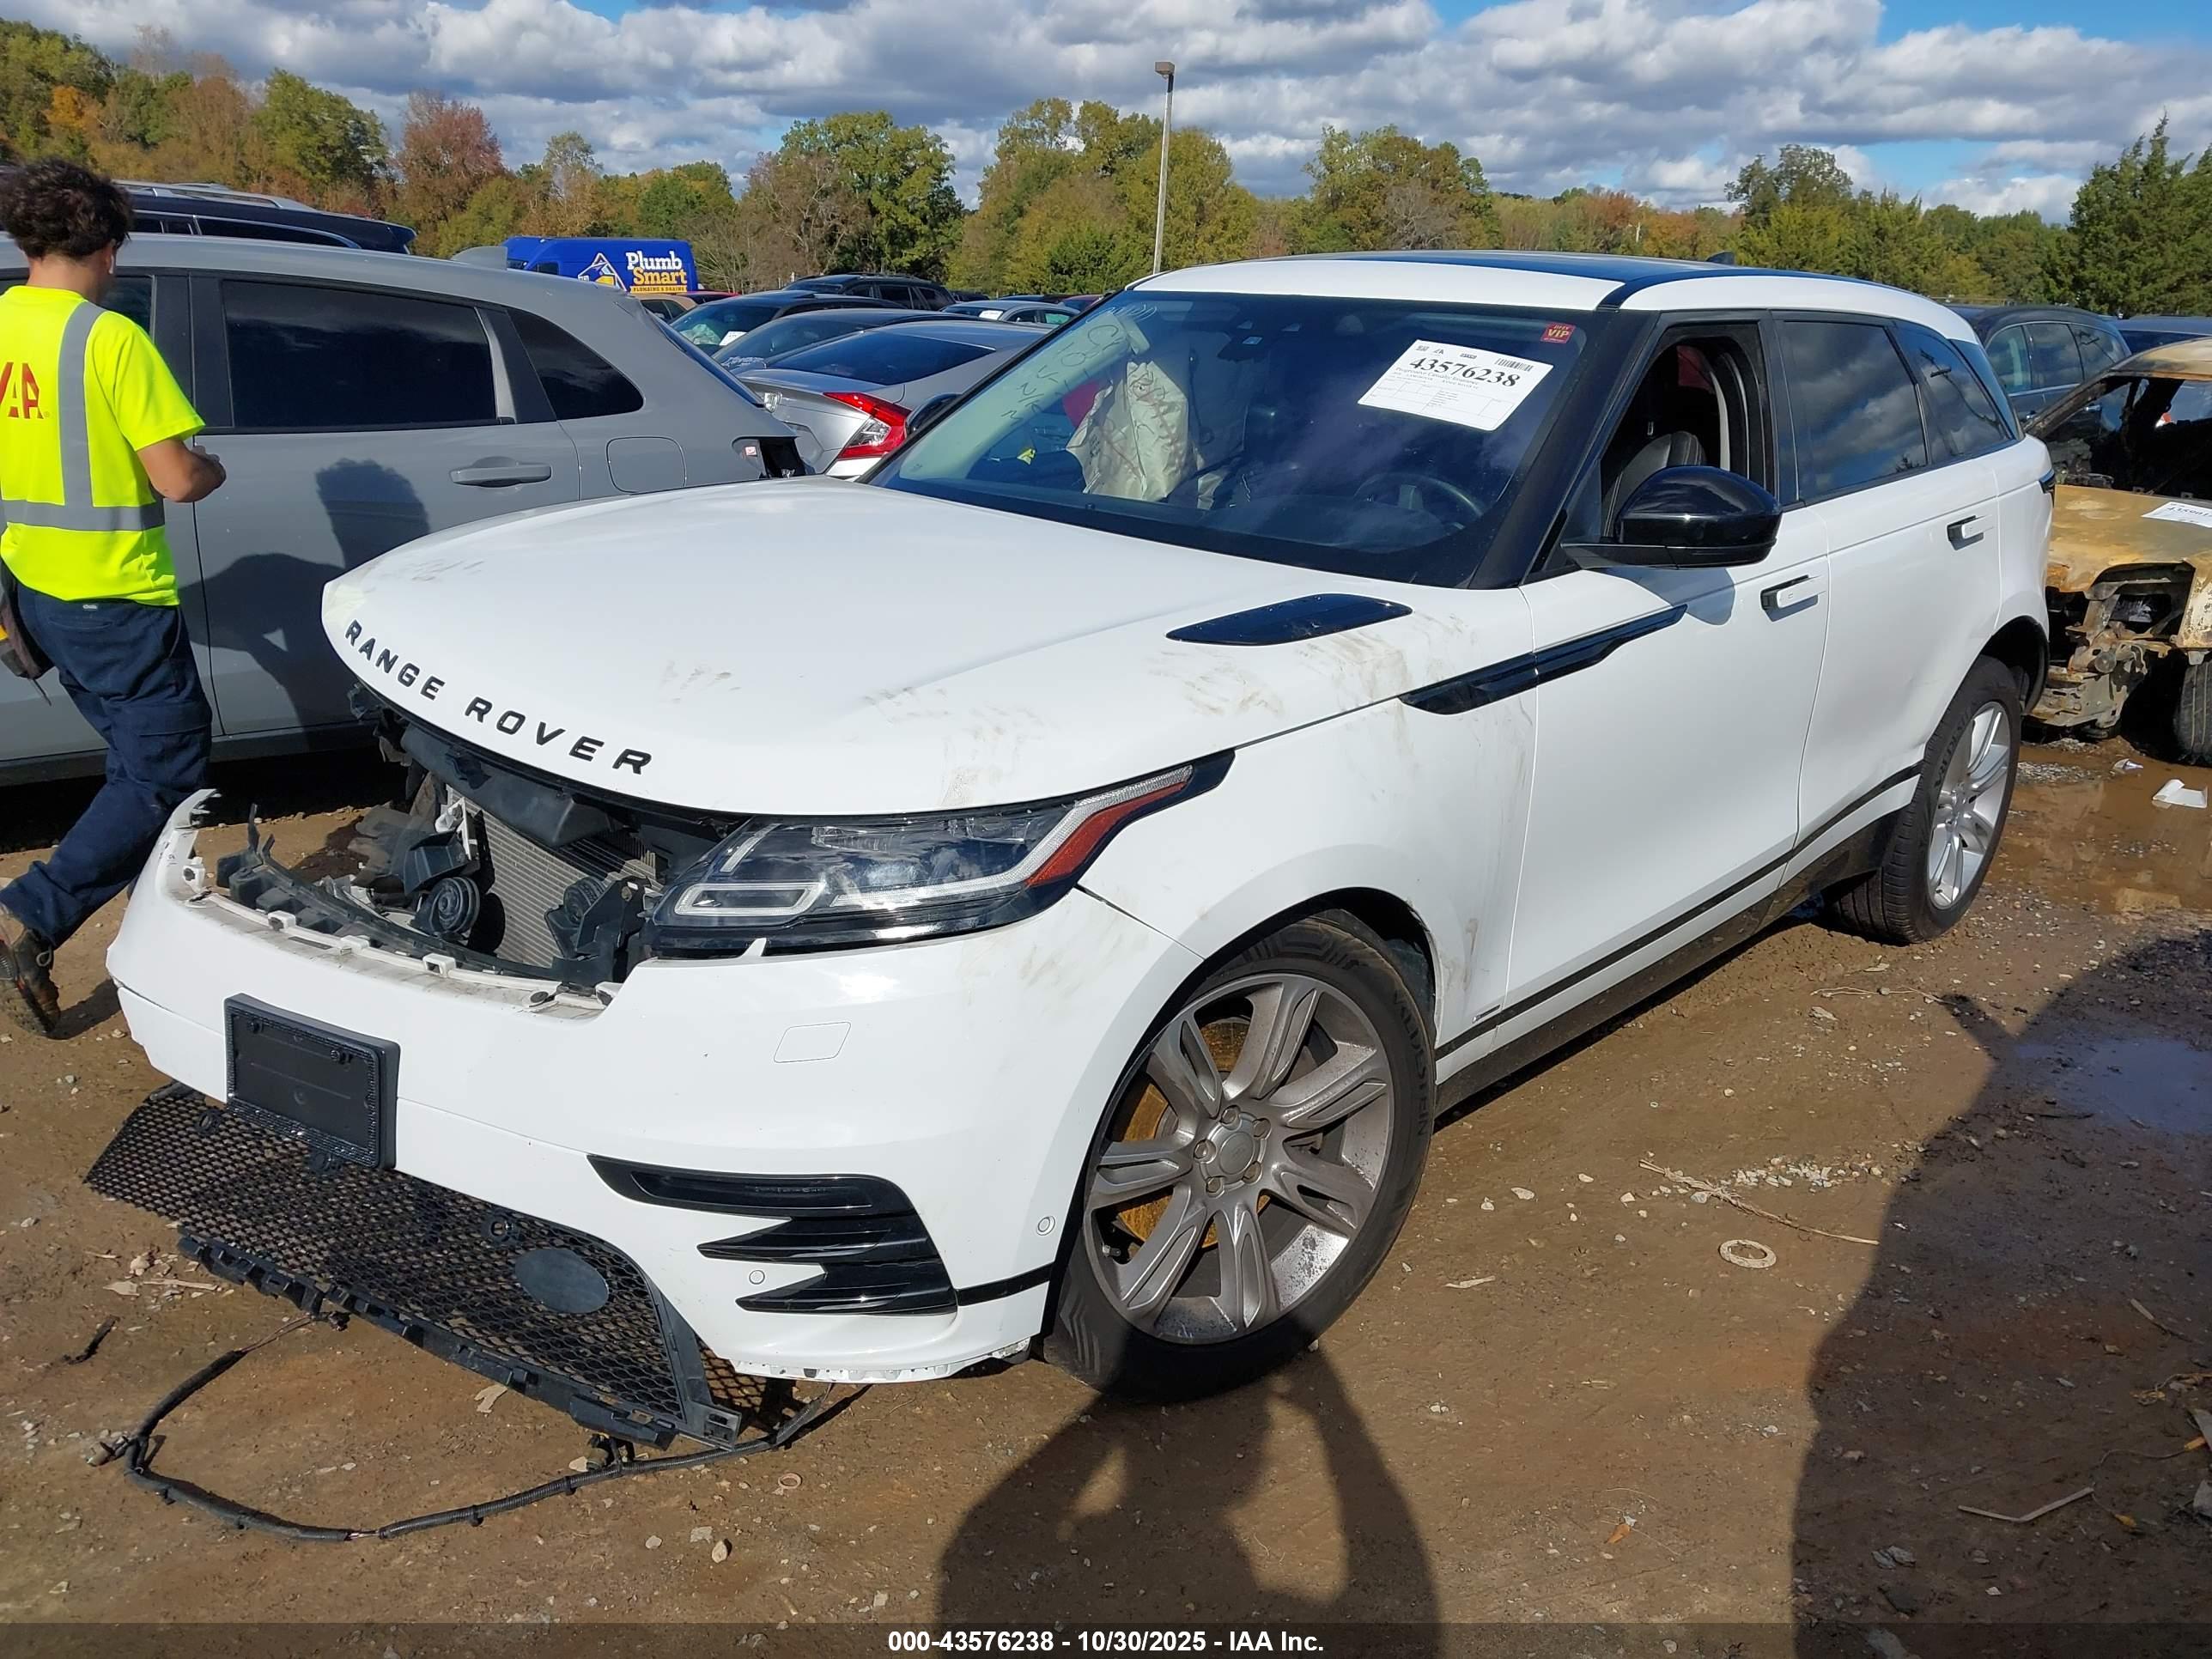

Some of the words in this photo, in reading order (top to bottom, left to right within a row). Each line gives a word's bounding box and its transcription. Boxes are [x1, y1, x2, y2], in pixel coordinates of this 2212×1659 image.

[625, 250, 683, 270] Plumb
[633, 266, 688, 285] Smart
[1547, 328, 1570, 338] VIP
[1409, 356, 1521, 387] 43576238
[345, 619, 445, 701] RANGE
[465, 696, 653, 775] ROVER
